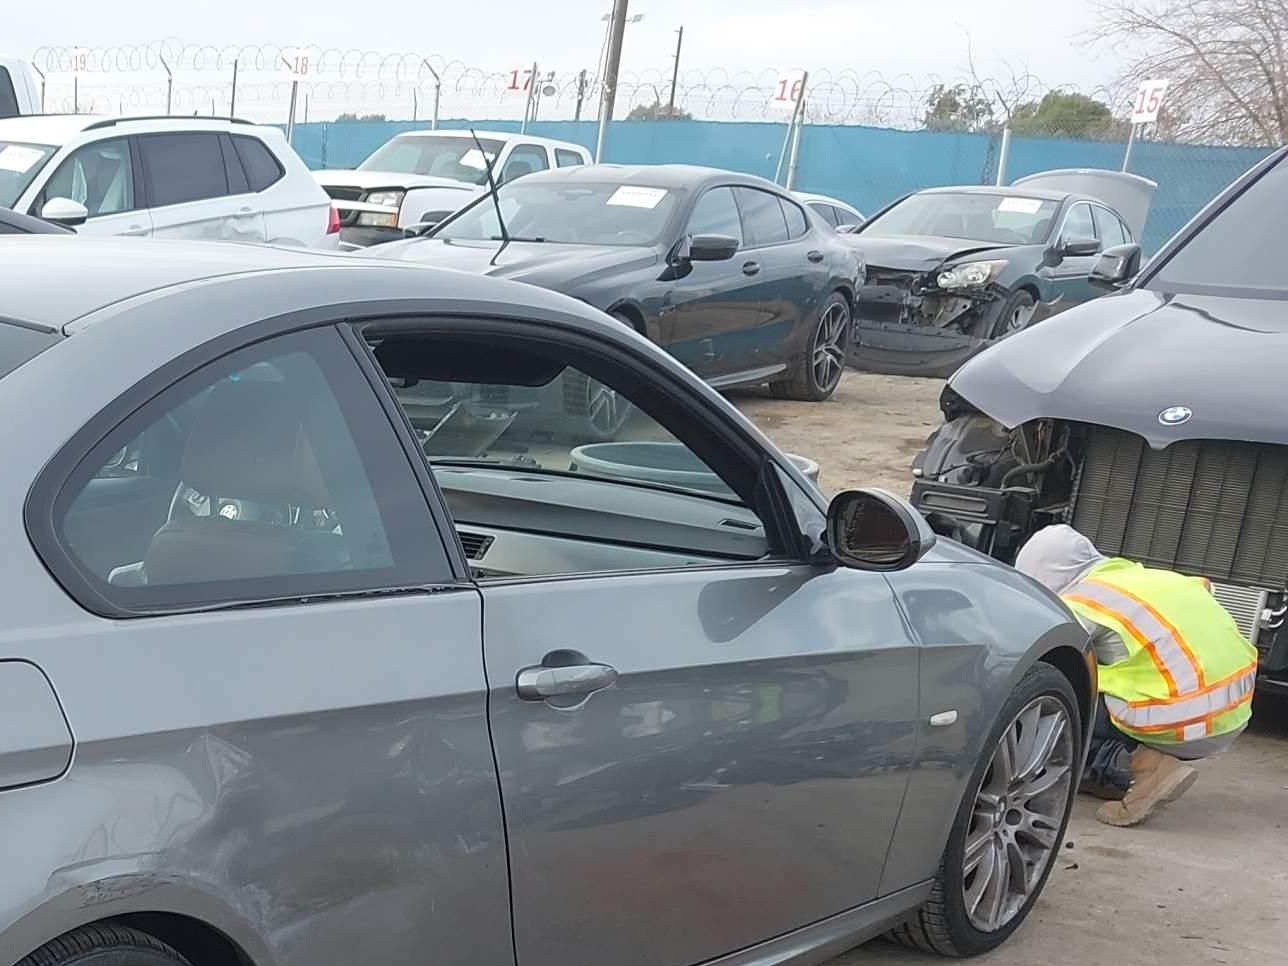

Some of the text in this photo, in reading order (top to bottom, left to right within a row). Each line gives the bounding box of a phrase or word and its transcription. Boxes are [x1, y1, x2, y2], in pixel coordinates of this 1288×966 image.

[73, 54, 86, 71] 19
[292, 56, 308, 75] 18
[507, 69, 533, 90] 17
[1135, 87, 1163, 114] 15
